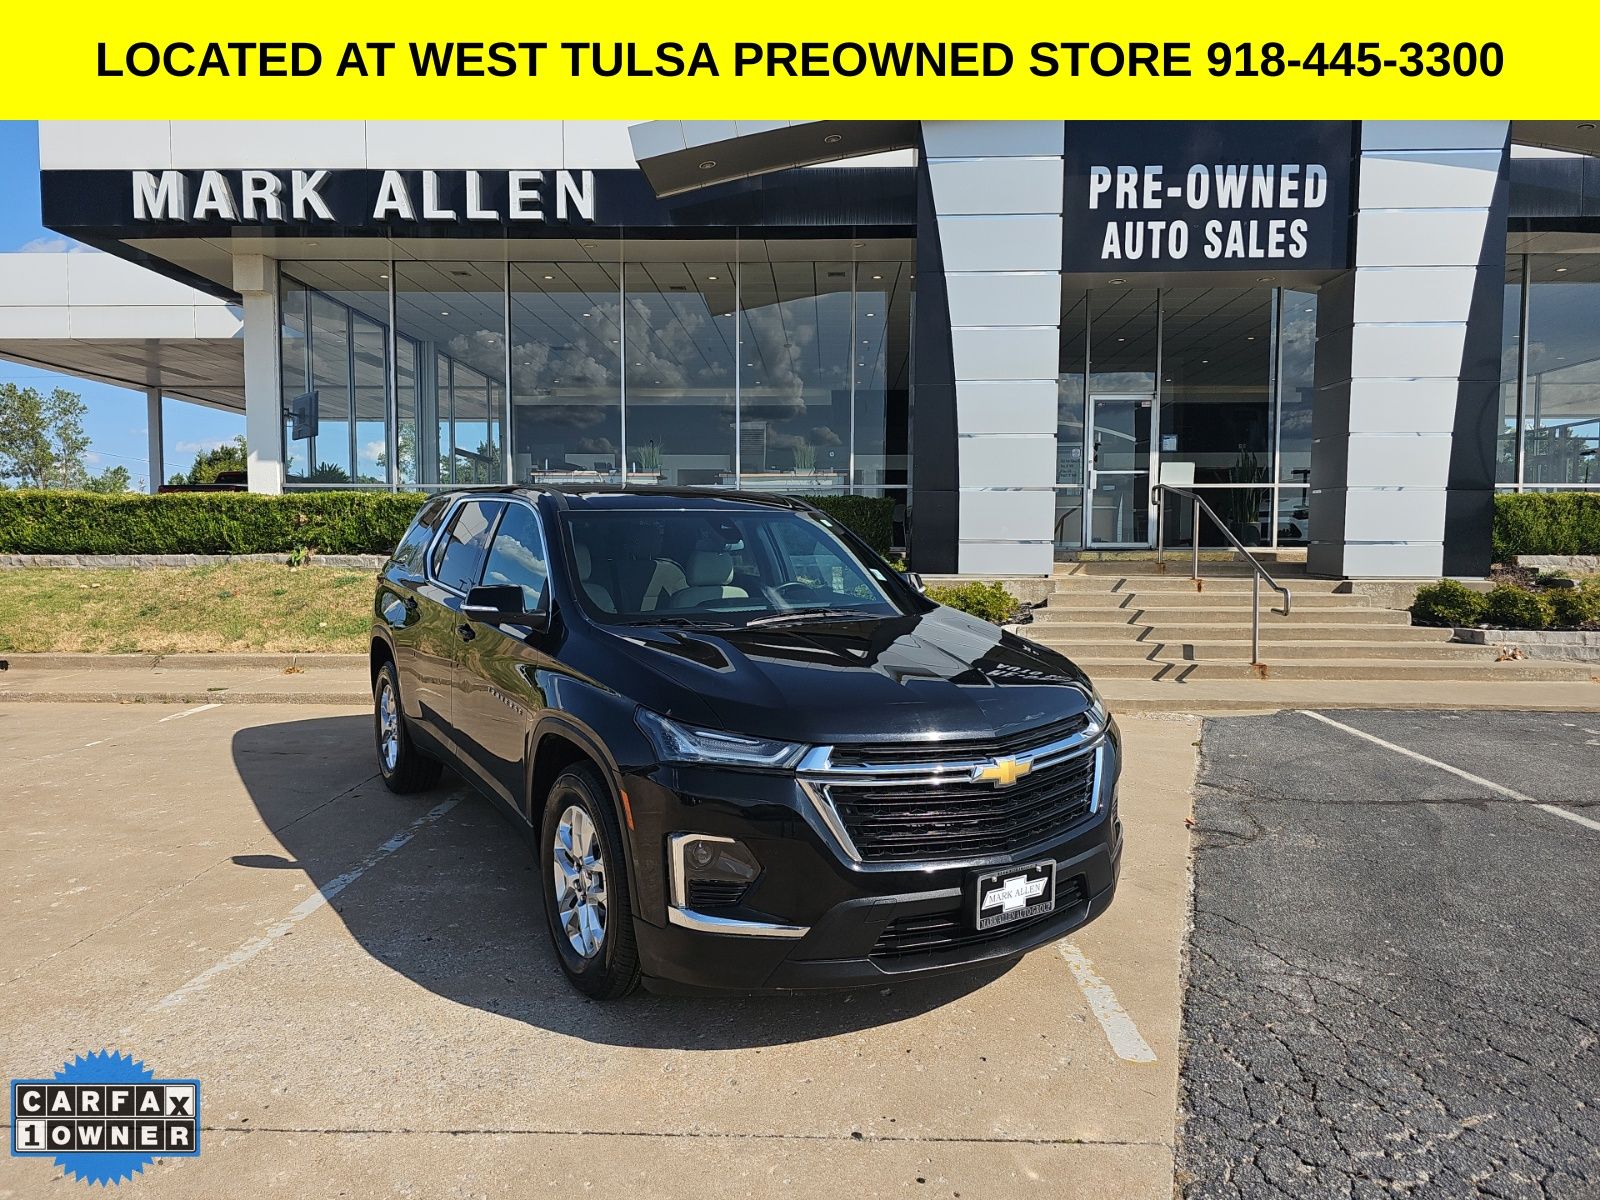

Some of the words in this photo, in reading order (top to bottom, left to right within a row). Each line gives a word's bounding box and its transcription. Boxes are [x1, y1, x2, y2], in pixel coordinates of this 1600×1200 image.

[132, 170, 335, 221] MARK
[372, 169, 596, 222] ALLEN
[1089, 163, 1328, 210] PRE-OWNED
[1101, 219, 1189, 260] AUTO
[1204, 218, 1308, 259] SALES
[989, 889, 1013, 904] MARK
[1014, 883, 1041, 898] ALLEN
